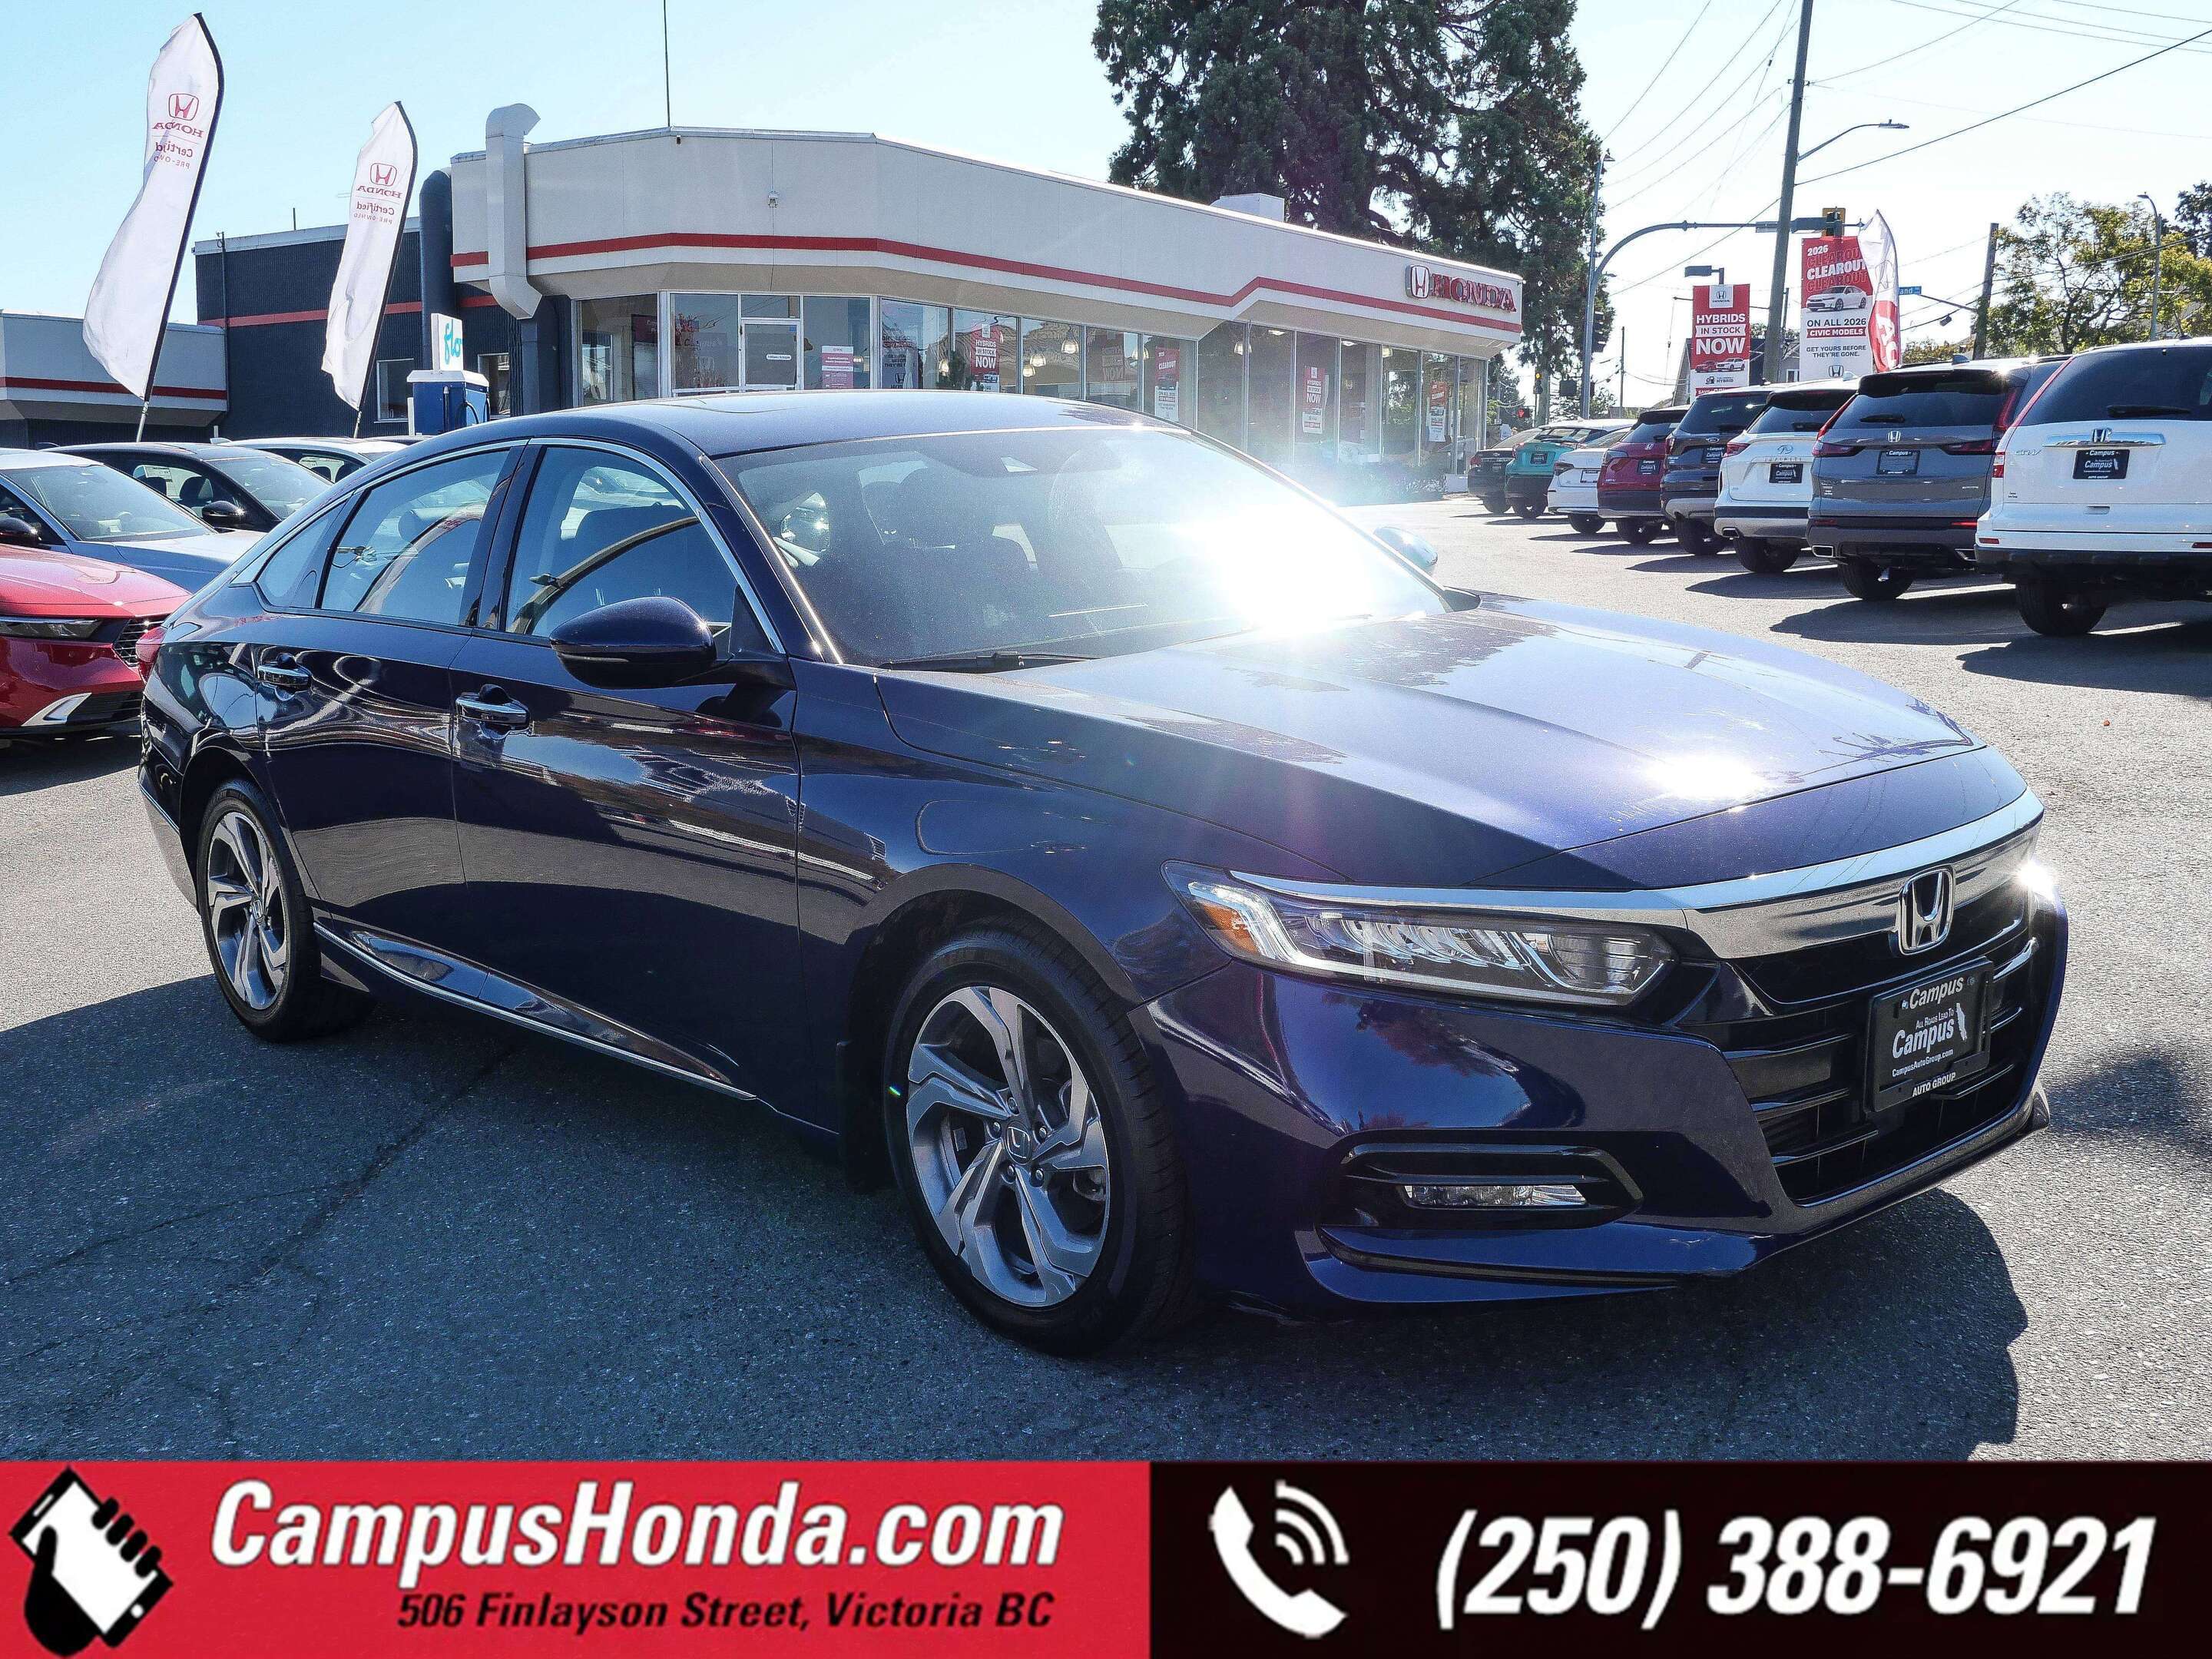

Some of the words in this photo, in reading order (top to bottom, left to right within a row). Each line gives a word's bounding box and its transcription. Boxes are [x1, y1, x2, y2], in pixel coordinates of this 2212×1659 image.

[1806, 247, 1862, 268] CLEAROU
[1807, 244, 1829, 257] 2026
[1806, 259, 1867, 280] CLEAROUT
[1430, 273, 1517, 313] HONDA
[1696, 313, 1746, 324] HYBRIDS
[1696, 337, 1746, 355] NOW
[975, 356, 997, 369] NOW
[1306, 393, 1321, 403] NOW
[2085, 461, 2113, 469] Campus
[1909, 977, 1964, 1010] Campus
[1892, 1018, 1955, 1058] Campus
[1892, 1048, 1954, 1078] CampusAutoGroup.com
[1912, 1081, 1931, 1098] AUTO
[1932, 1071, 1956, 1089] GROUP
